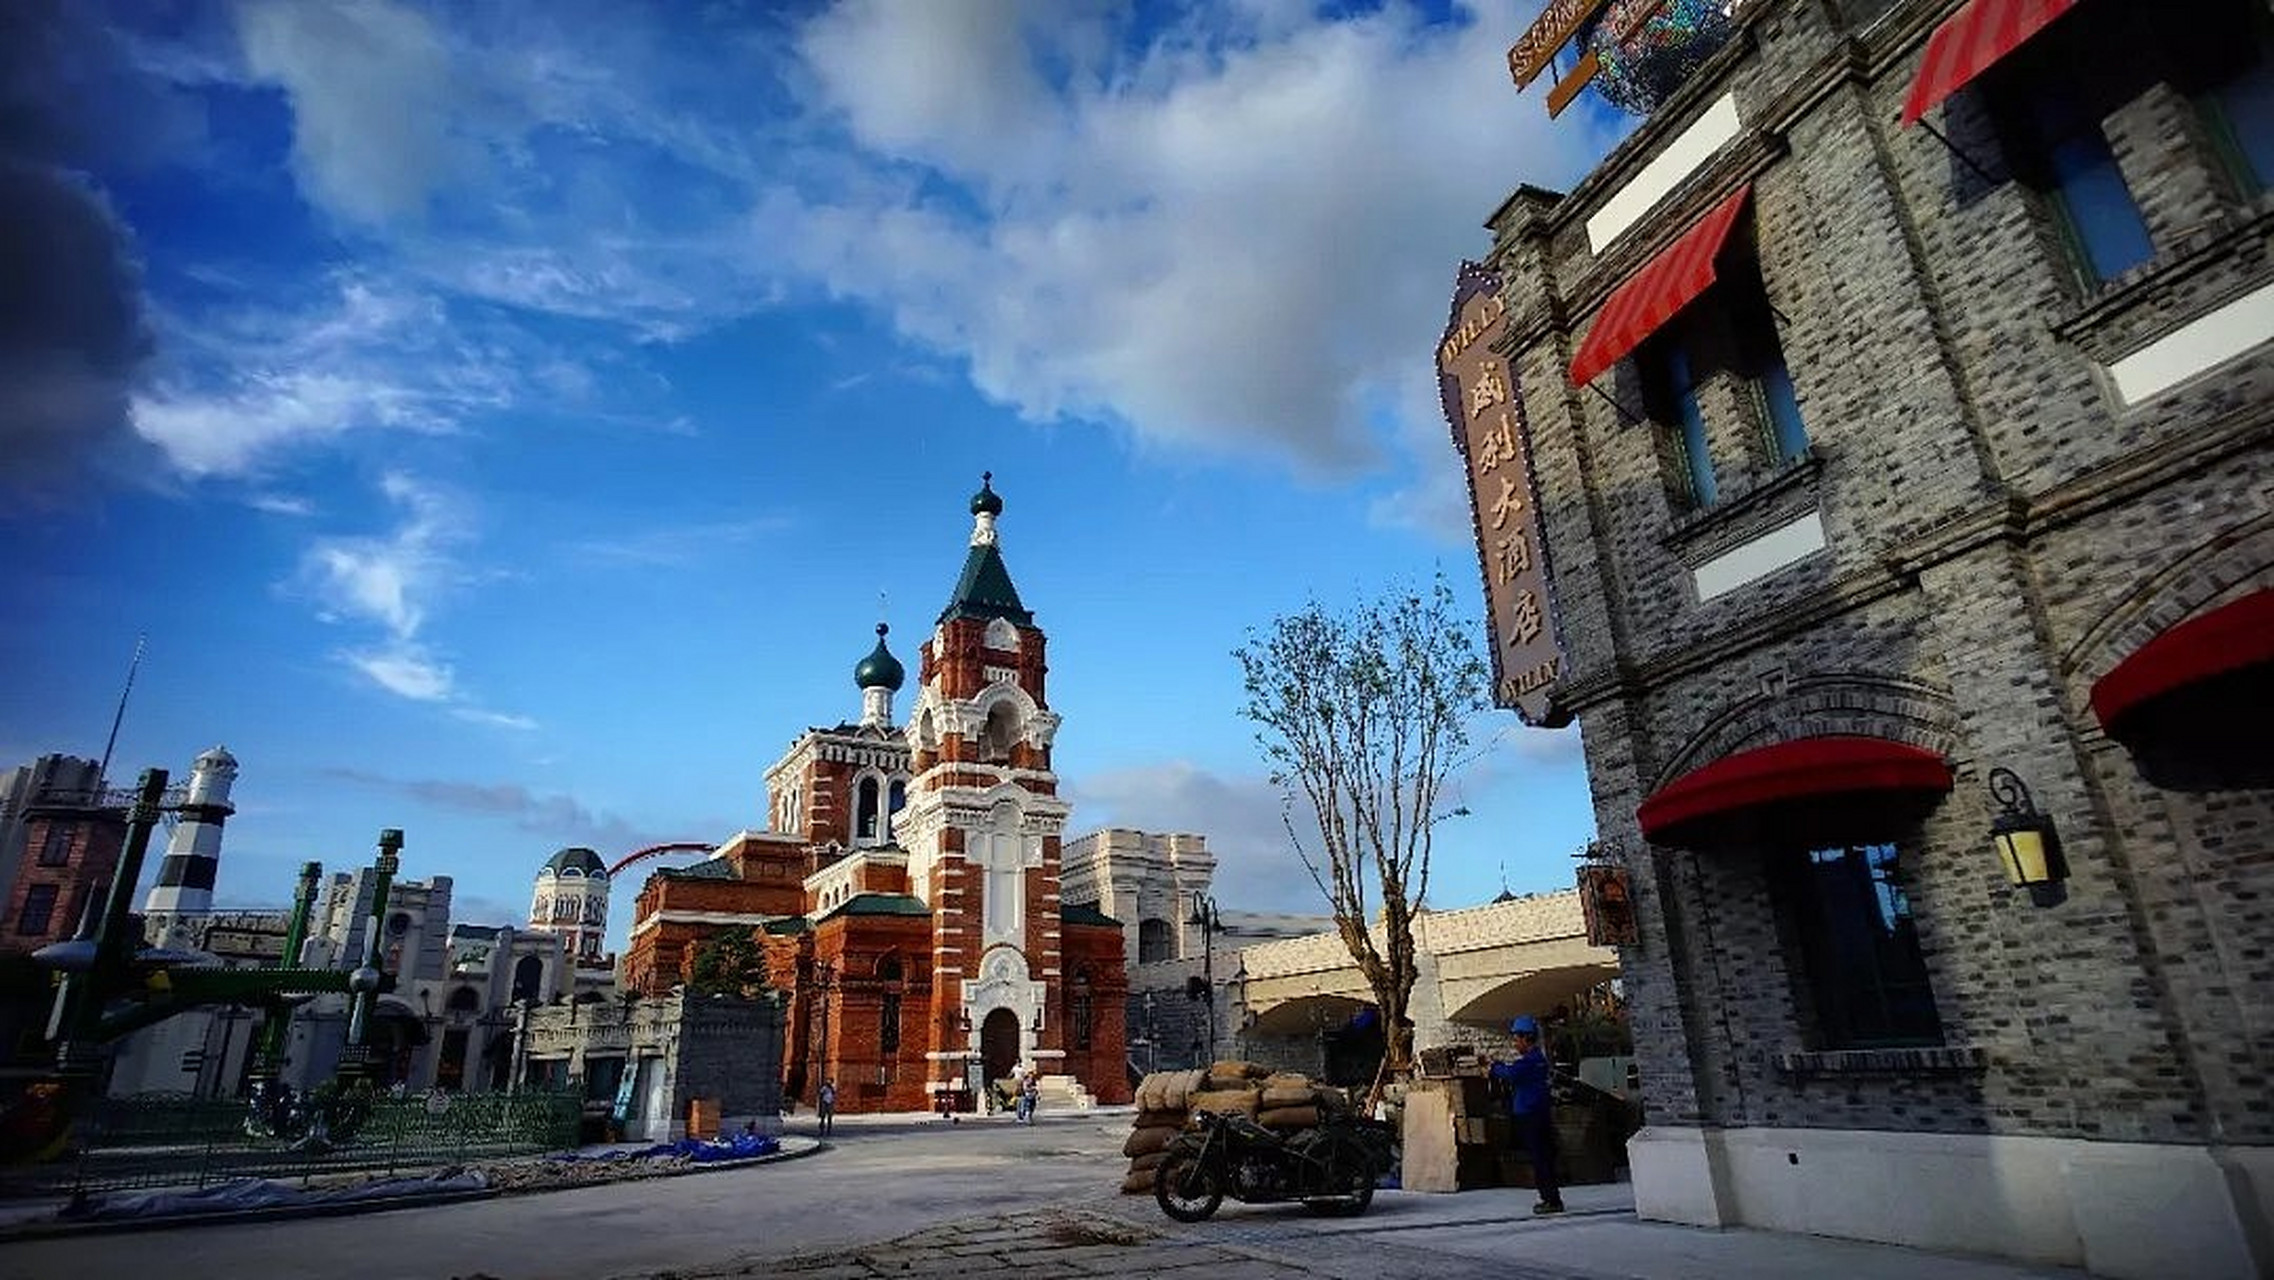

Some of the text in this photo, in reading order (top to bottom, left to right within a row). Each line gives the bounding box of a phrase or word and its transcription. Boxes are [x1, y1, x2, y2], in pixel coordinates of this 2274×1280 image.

[1444, 294, 1507, 360] WILLY
[1470, 361, 1542, 646] 威利大酒店
[1504, 655, 1559, 697] WILLY
